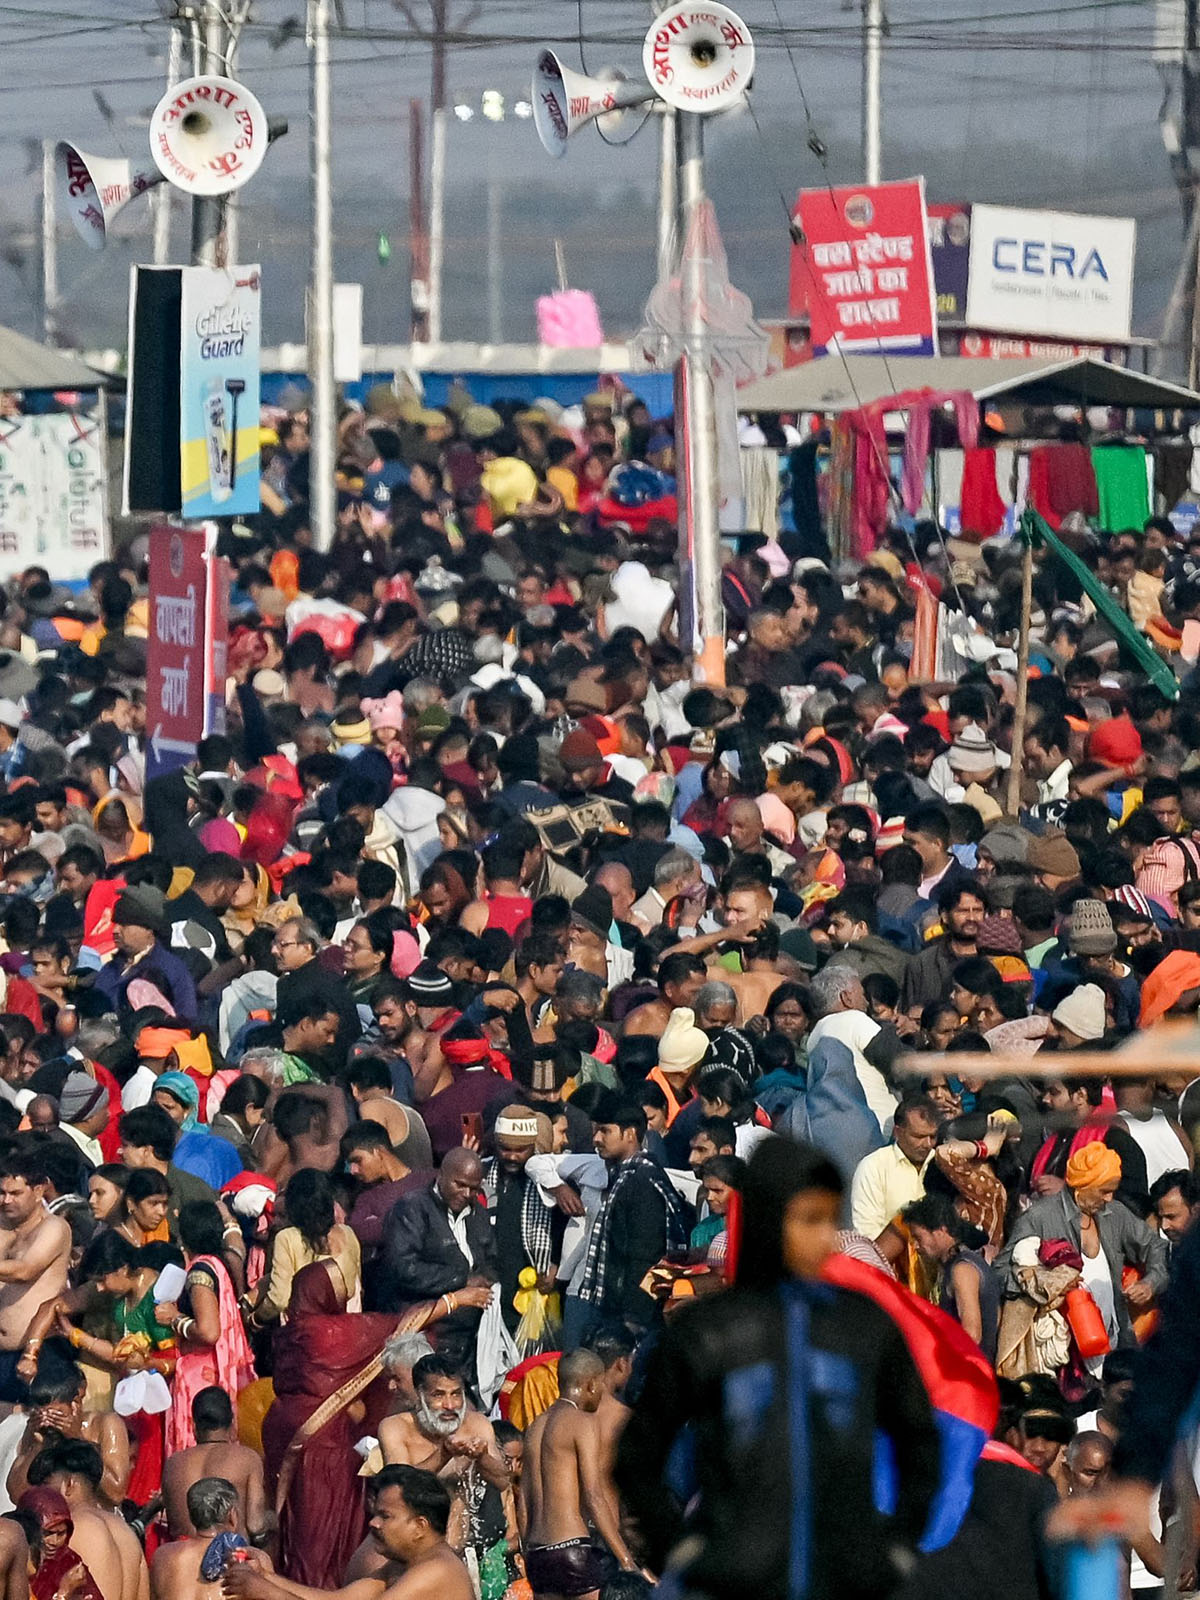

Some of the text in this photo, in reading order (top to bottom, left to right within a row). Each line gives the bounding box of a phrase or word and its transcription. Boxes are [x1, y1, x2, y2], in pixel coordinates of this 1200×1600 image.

[812, 241, 853, 267] बस
[993, 237, 1109, 282] CERA
[823, 263, 908, 296] जाने का
[195, 304, 253, 338] Gillette
[836, 297, 900, 326] रास्ता
[201, 333, 245, 359] Guard
[156, 584, 196, 646] वापसी
[160, 655, 189, 717] मार्ग
